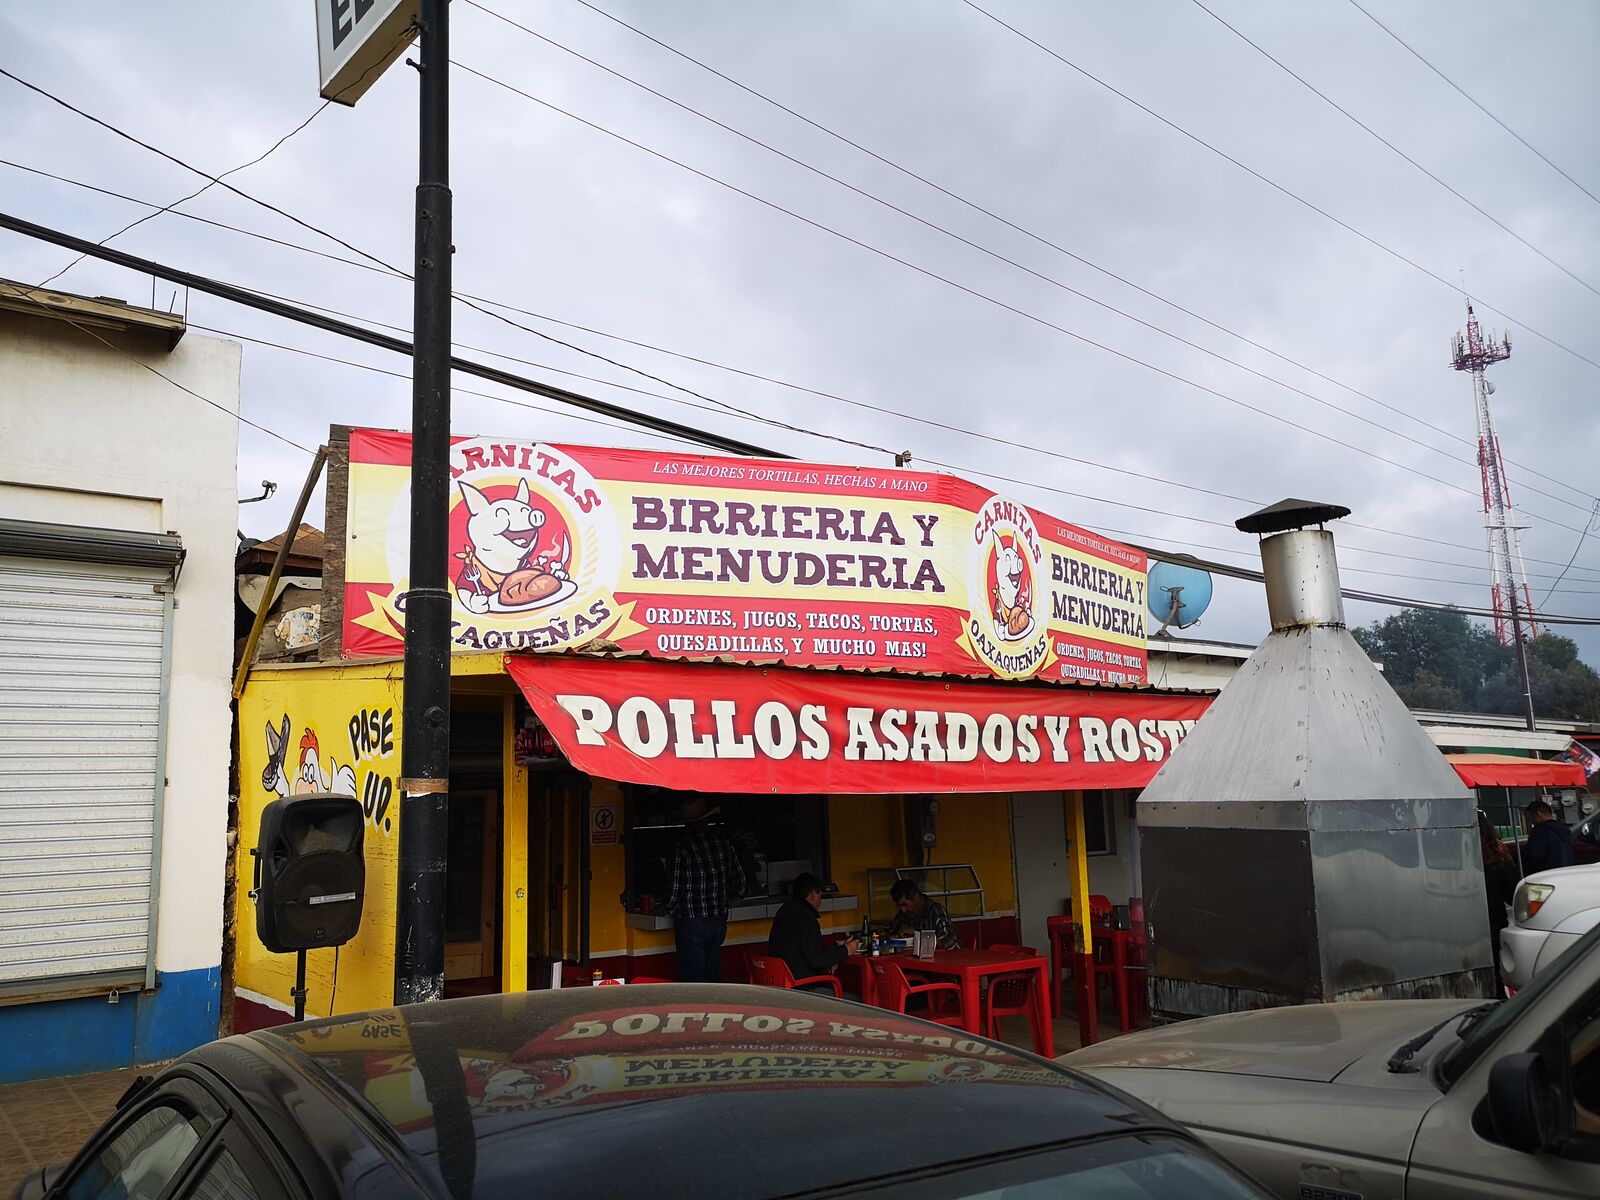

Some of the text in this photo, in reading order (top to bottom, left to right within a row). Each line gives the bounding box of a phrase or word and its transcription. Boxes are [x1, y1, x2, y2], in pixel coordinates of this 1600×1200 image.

[653, 461, 928, 493] LAS MEJORES TORTILLAS, HECHAS A MANO
[631, 495, 939, 547] BIRRIERIA Y
[974, 500, 1042, 565] CARNITAS
[631, 543, 946, 593] MENUDERIA
[1051, 552, 1144, 605] BIRRIERIA Y
[645, 607, 938, 636] ORDENES, JUGOS, TACOS, TORTAS,
[1051, 590, 1145, 640] MENUDERIA
[657, 634, 927, 658] QUESADILLAS, Y MUCHO MAS!
[970, 619, 1046, 675] OAXAQUEÑAS
[1056, 642, 1086, 662] ORDENES,
[1087, 647, 1105, 665] JUGOS,
[348, 707, 394, 764] PASE
[556, 694, 830, 761] POLLOS
[844, 707, 1041, 763] ASADOS
[1044, 716, 1070, 763] Y
